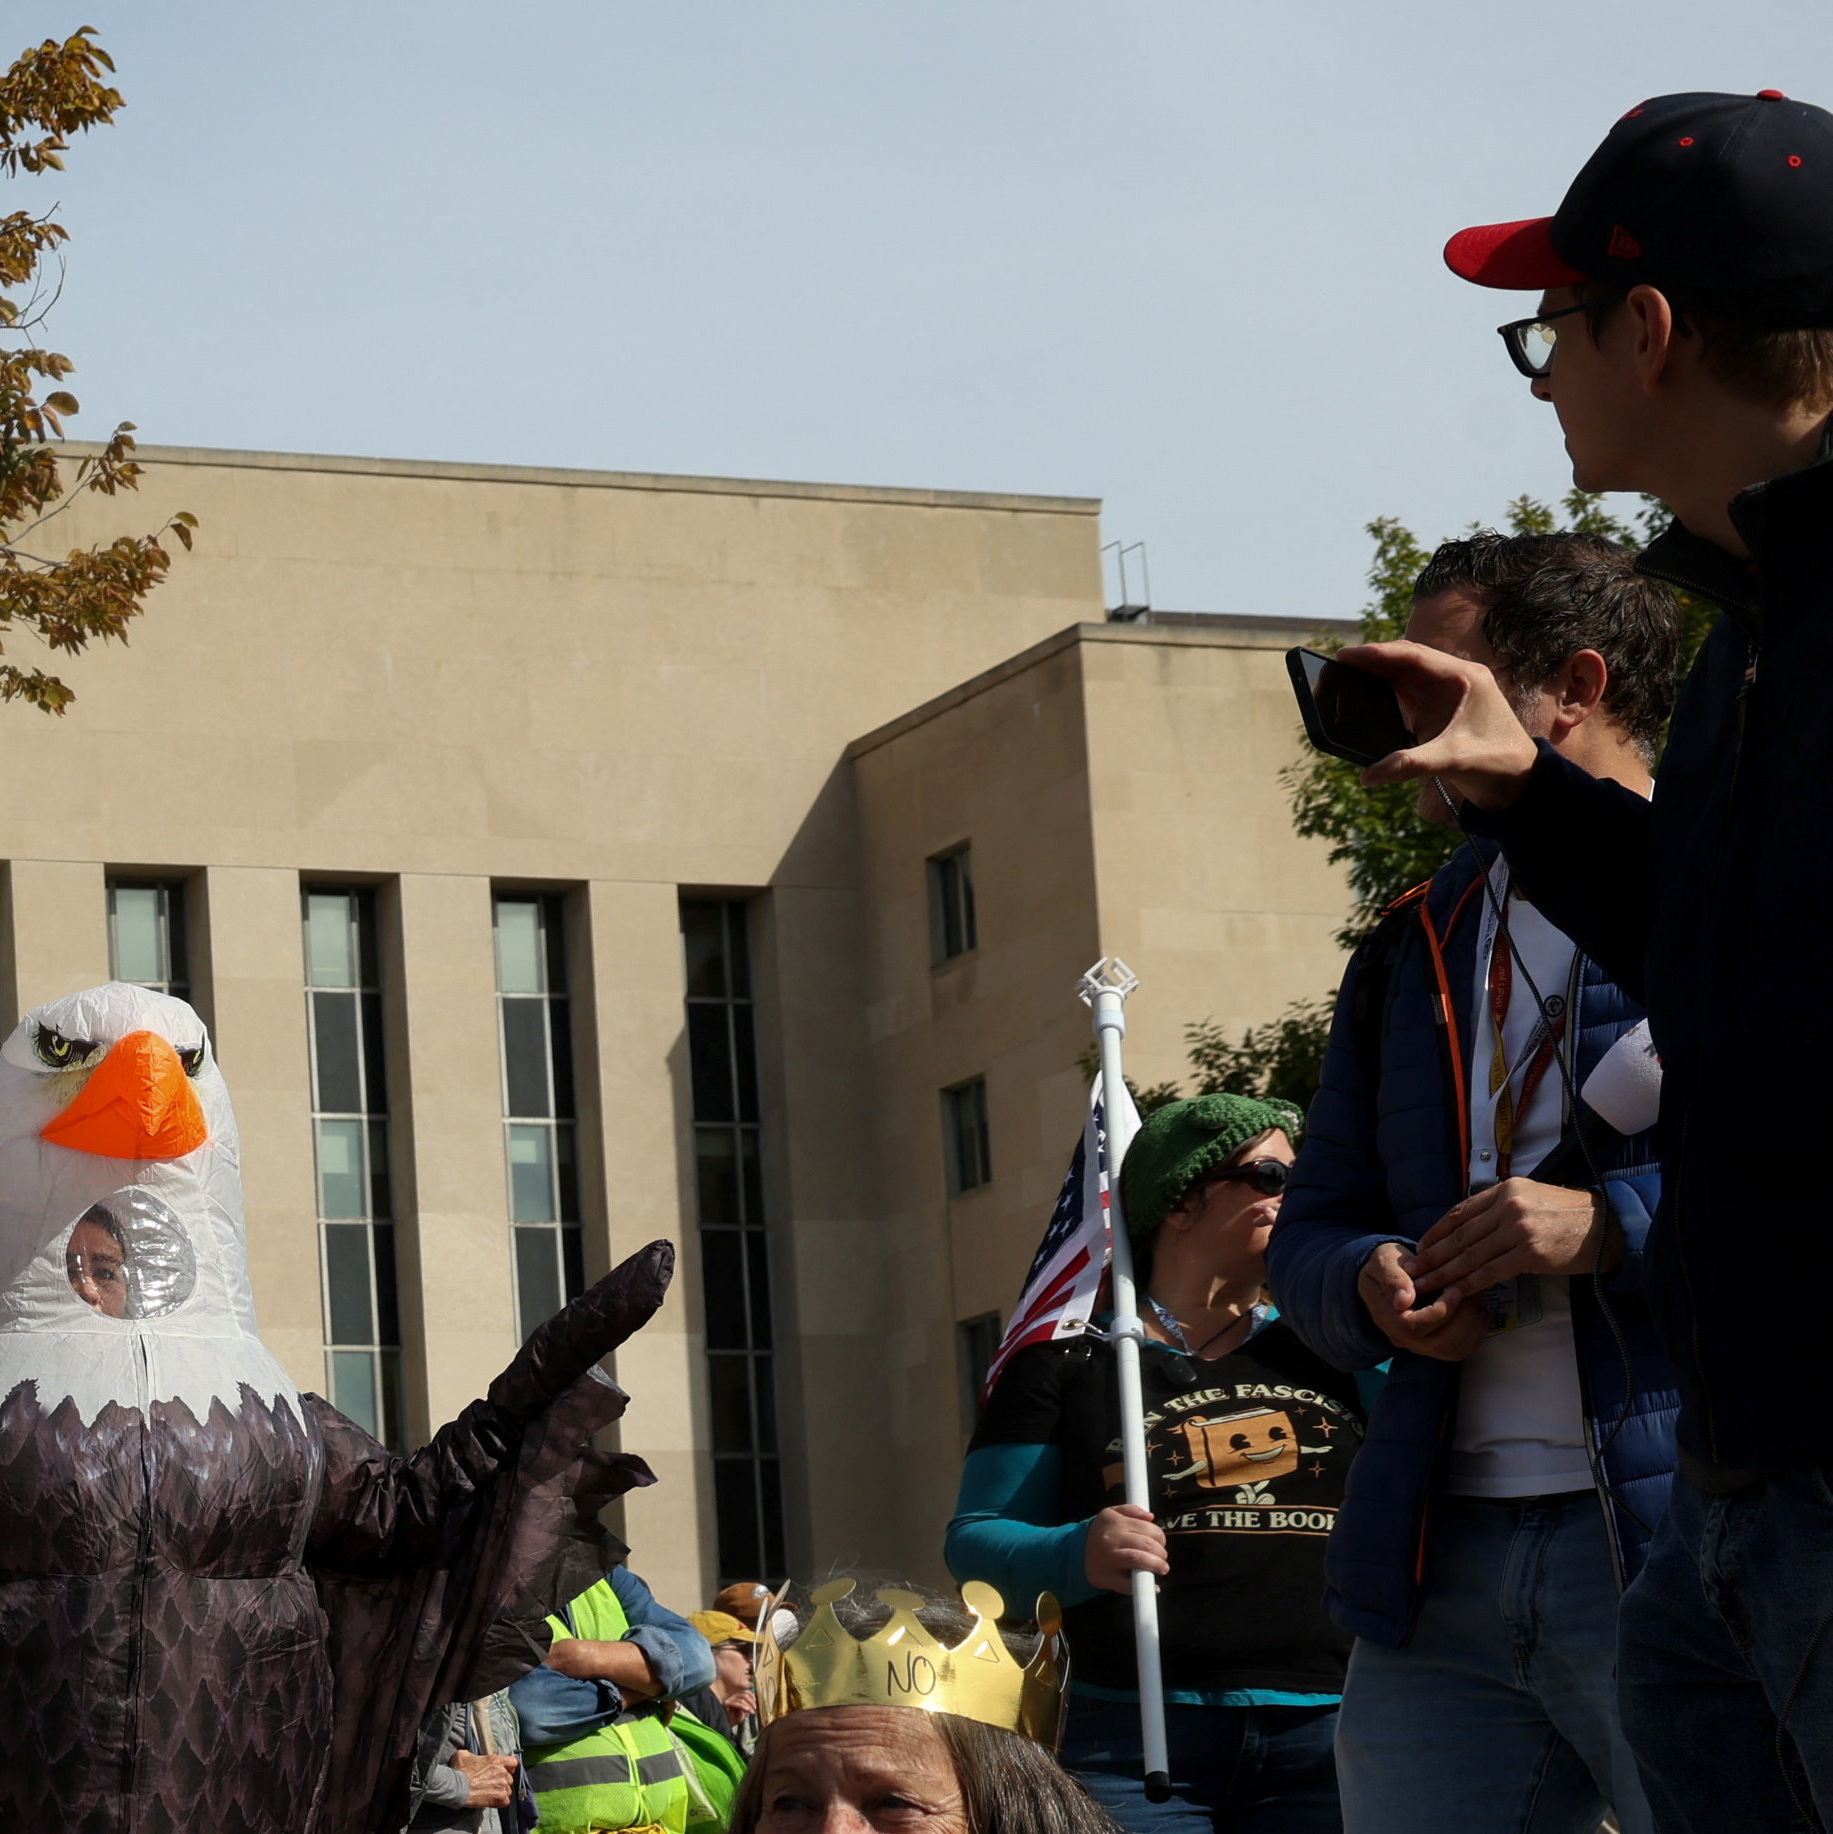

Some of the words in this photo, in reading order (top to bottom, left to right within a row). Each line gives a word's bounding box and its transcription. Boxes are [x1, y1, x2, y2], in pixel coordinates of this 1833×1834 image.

[1164, 1387, 1228, 1412] THE
[1205, 1511, 1261, 1529] THE
[1269, 1511, 1336, 1531] BOO
[886, 1650, 936, 1697] NO
